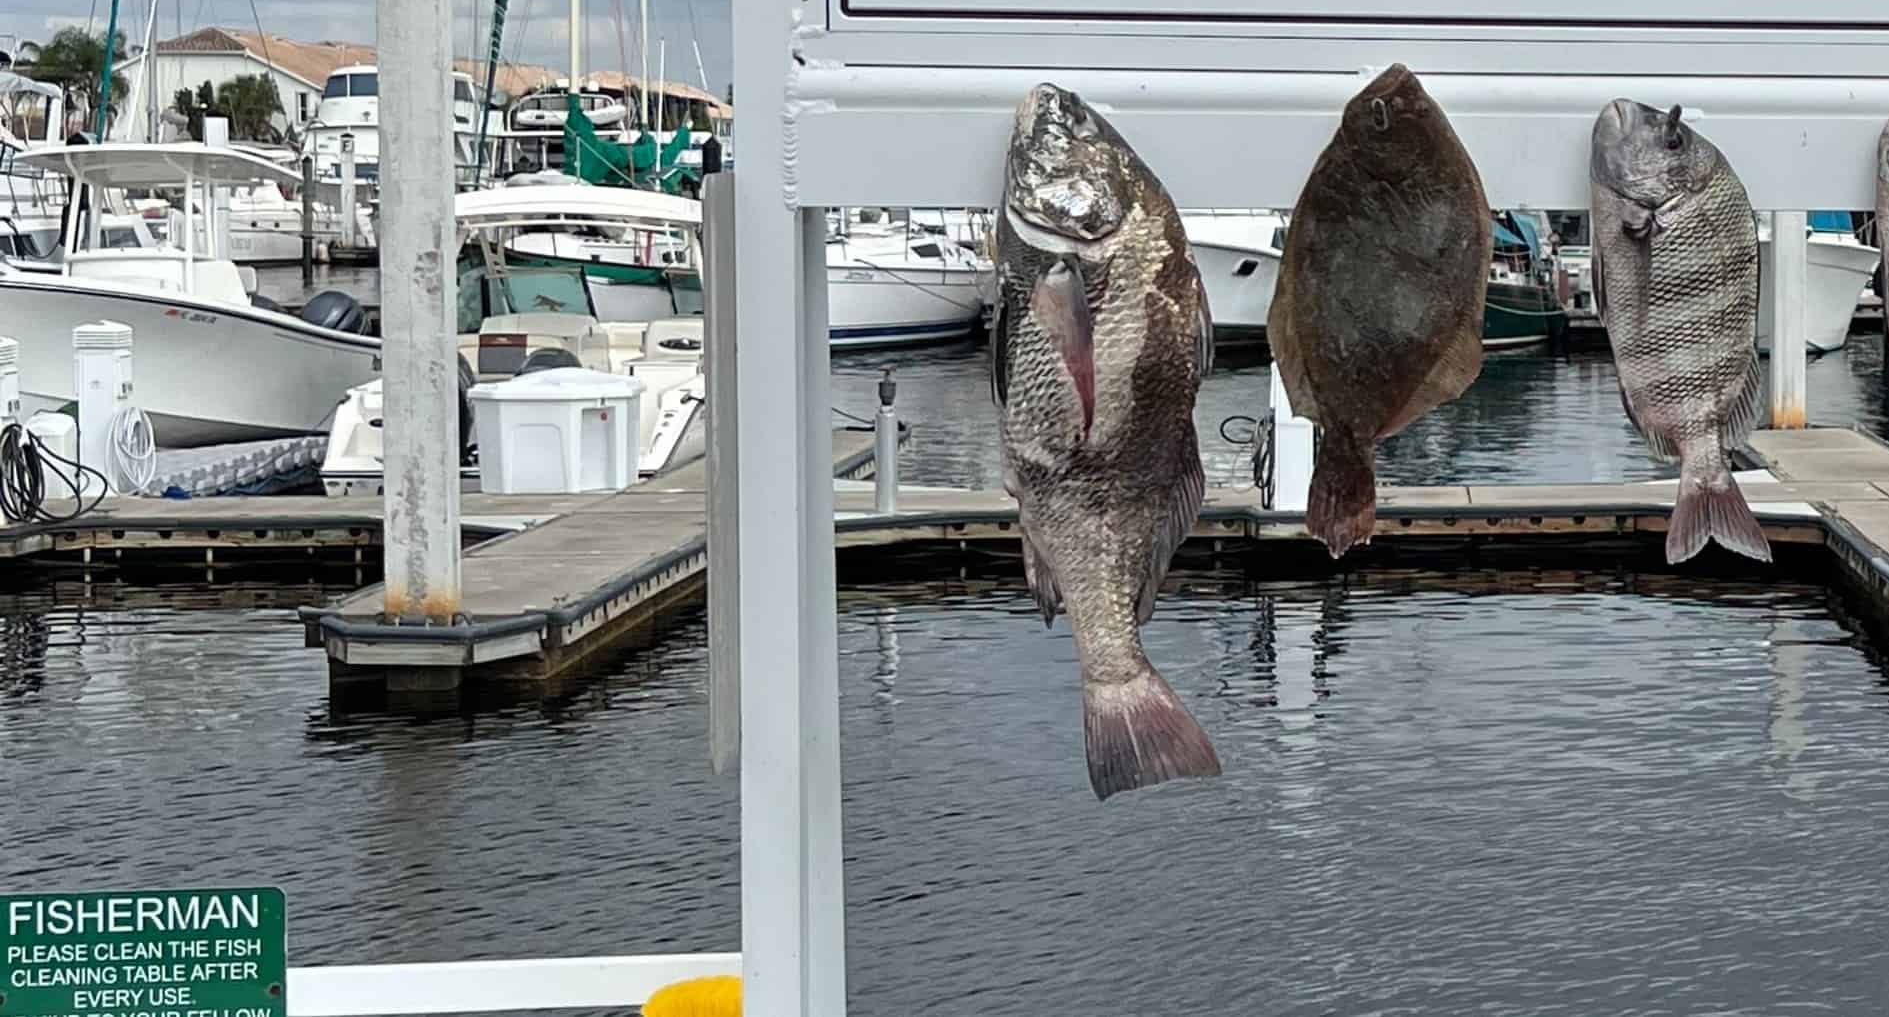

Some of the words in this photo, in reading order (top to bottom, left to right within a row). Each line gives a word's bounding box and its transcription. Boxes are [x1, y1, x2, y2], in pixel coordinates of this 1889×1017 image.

[9, 894, 259, 935] FISHERMAN
[8, 944, 88, 963] PLEASE
[94, 942, 162, 961] CLEAN
[168, 940, 209, 958] THE
[216, 939, 260, 956] FISH
[11, 967, 117, 987] CLEANING
[122, 964, 186, 983] TABLE
[191, 962, 258, 981] AFTER
[74, 989, 144, 1008] EVERY
[149, 987, 196, 1006] USE.
